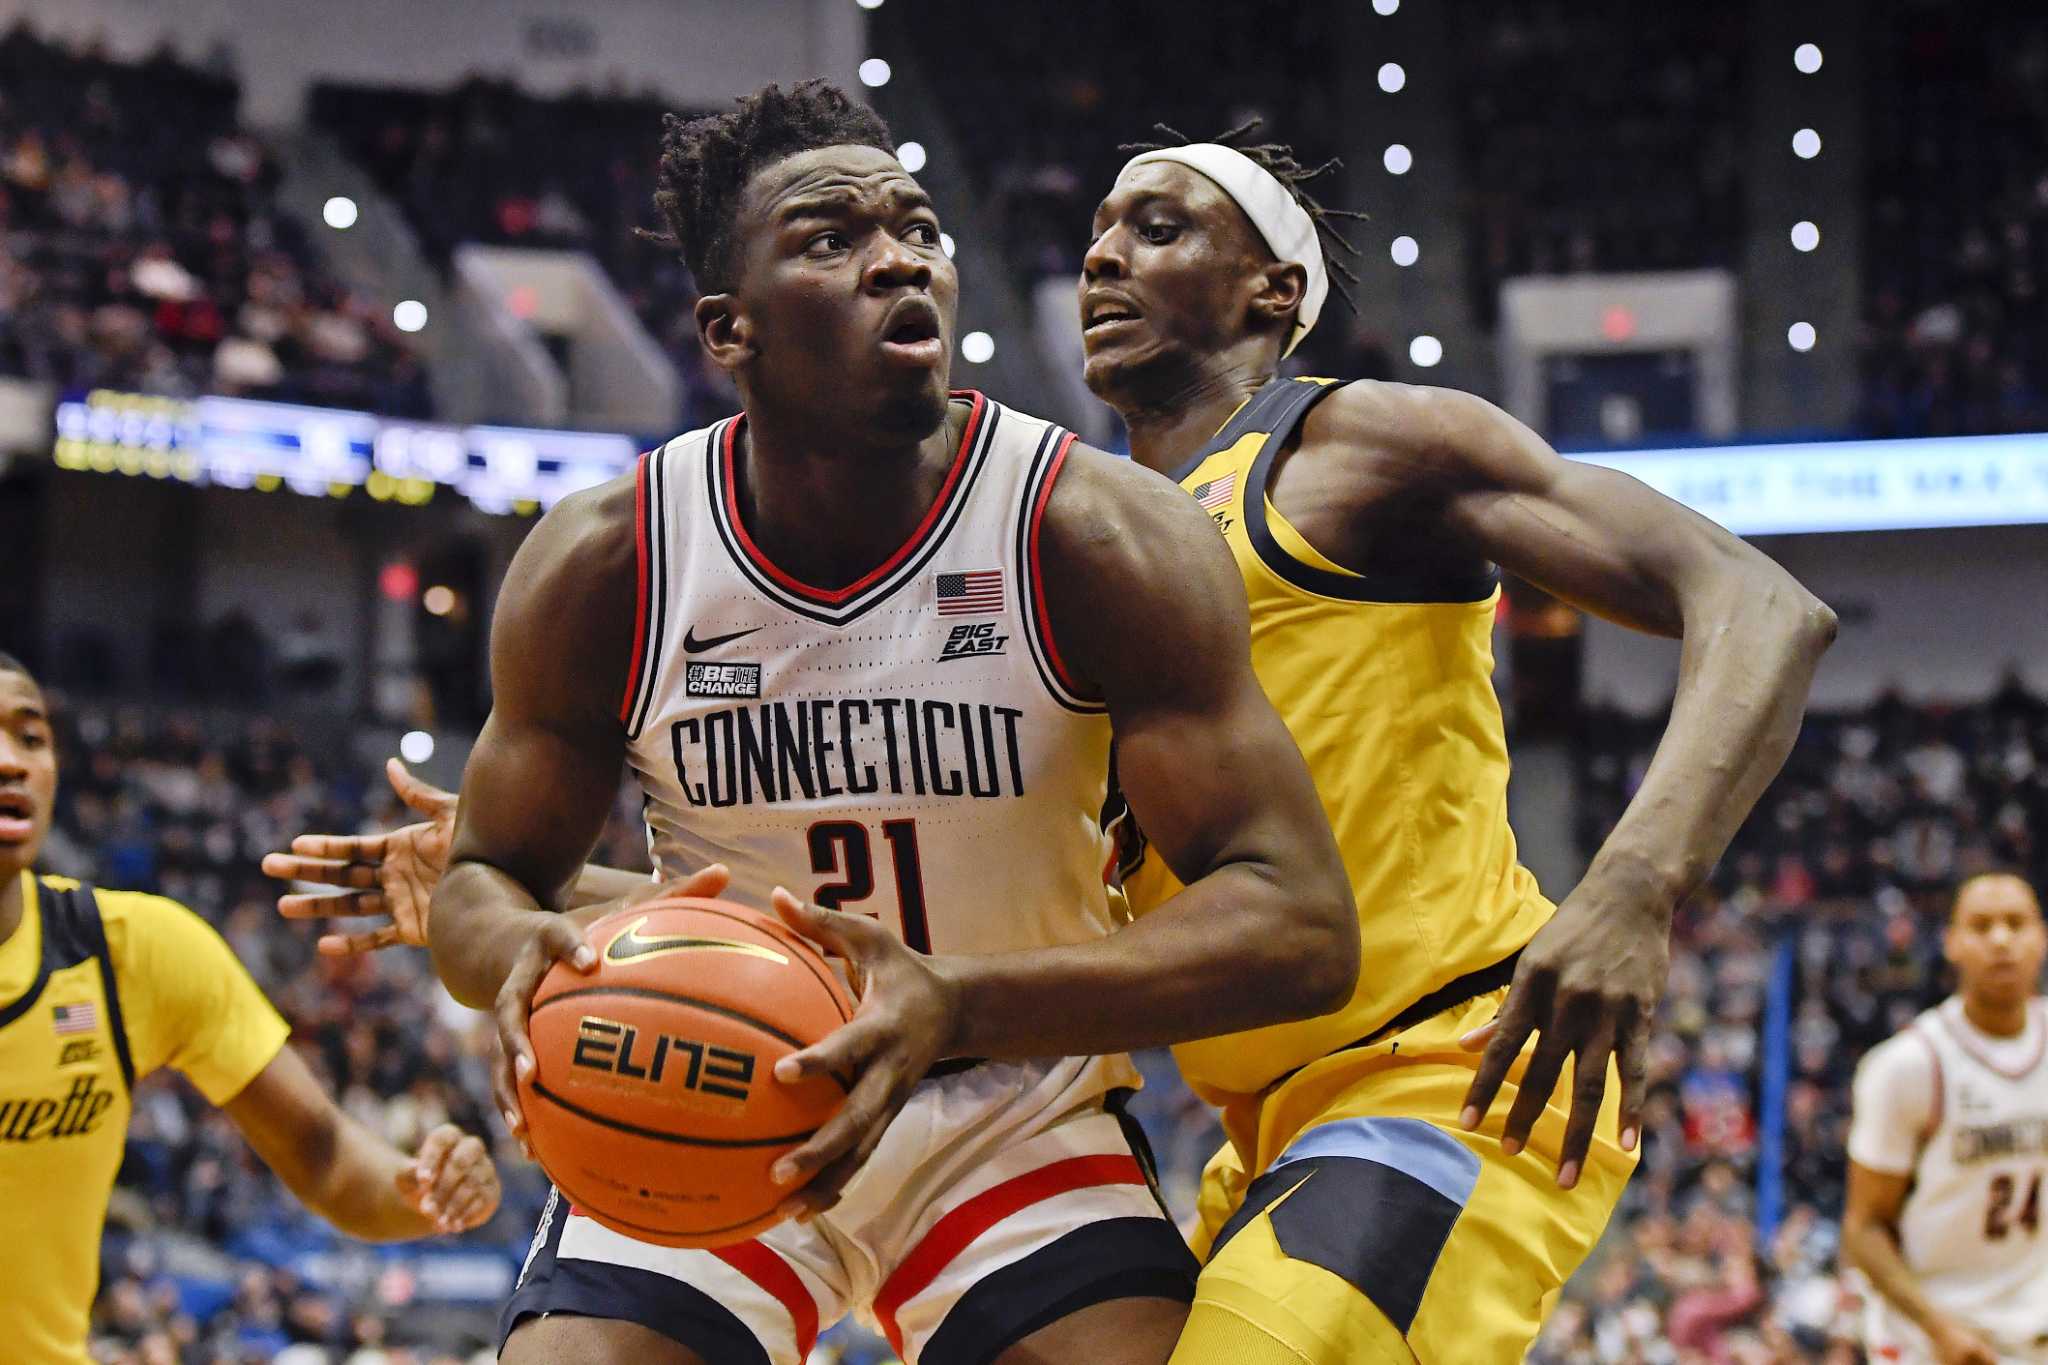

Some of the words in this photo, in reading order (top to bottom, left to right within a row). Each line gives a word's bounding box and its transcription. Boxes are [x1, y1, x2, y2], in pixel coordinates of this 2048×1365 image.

[942, 635, 1009, 654] EAST
[948, 623, 997, 640] BIG
[688, 681, 758, 694] CHANGE
[671, 698, 1023, 807] CONNECTICUT
[806, 818, 933, 956] 21
[573, 1015, 756, 1100] ELITE
[1983, 1173, 2042, 1240] 24
